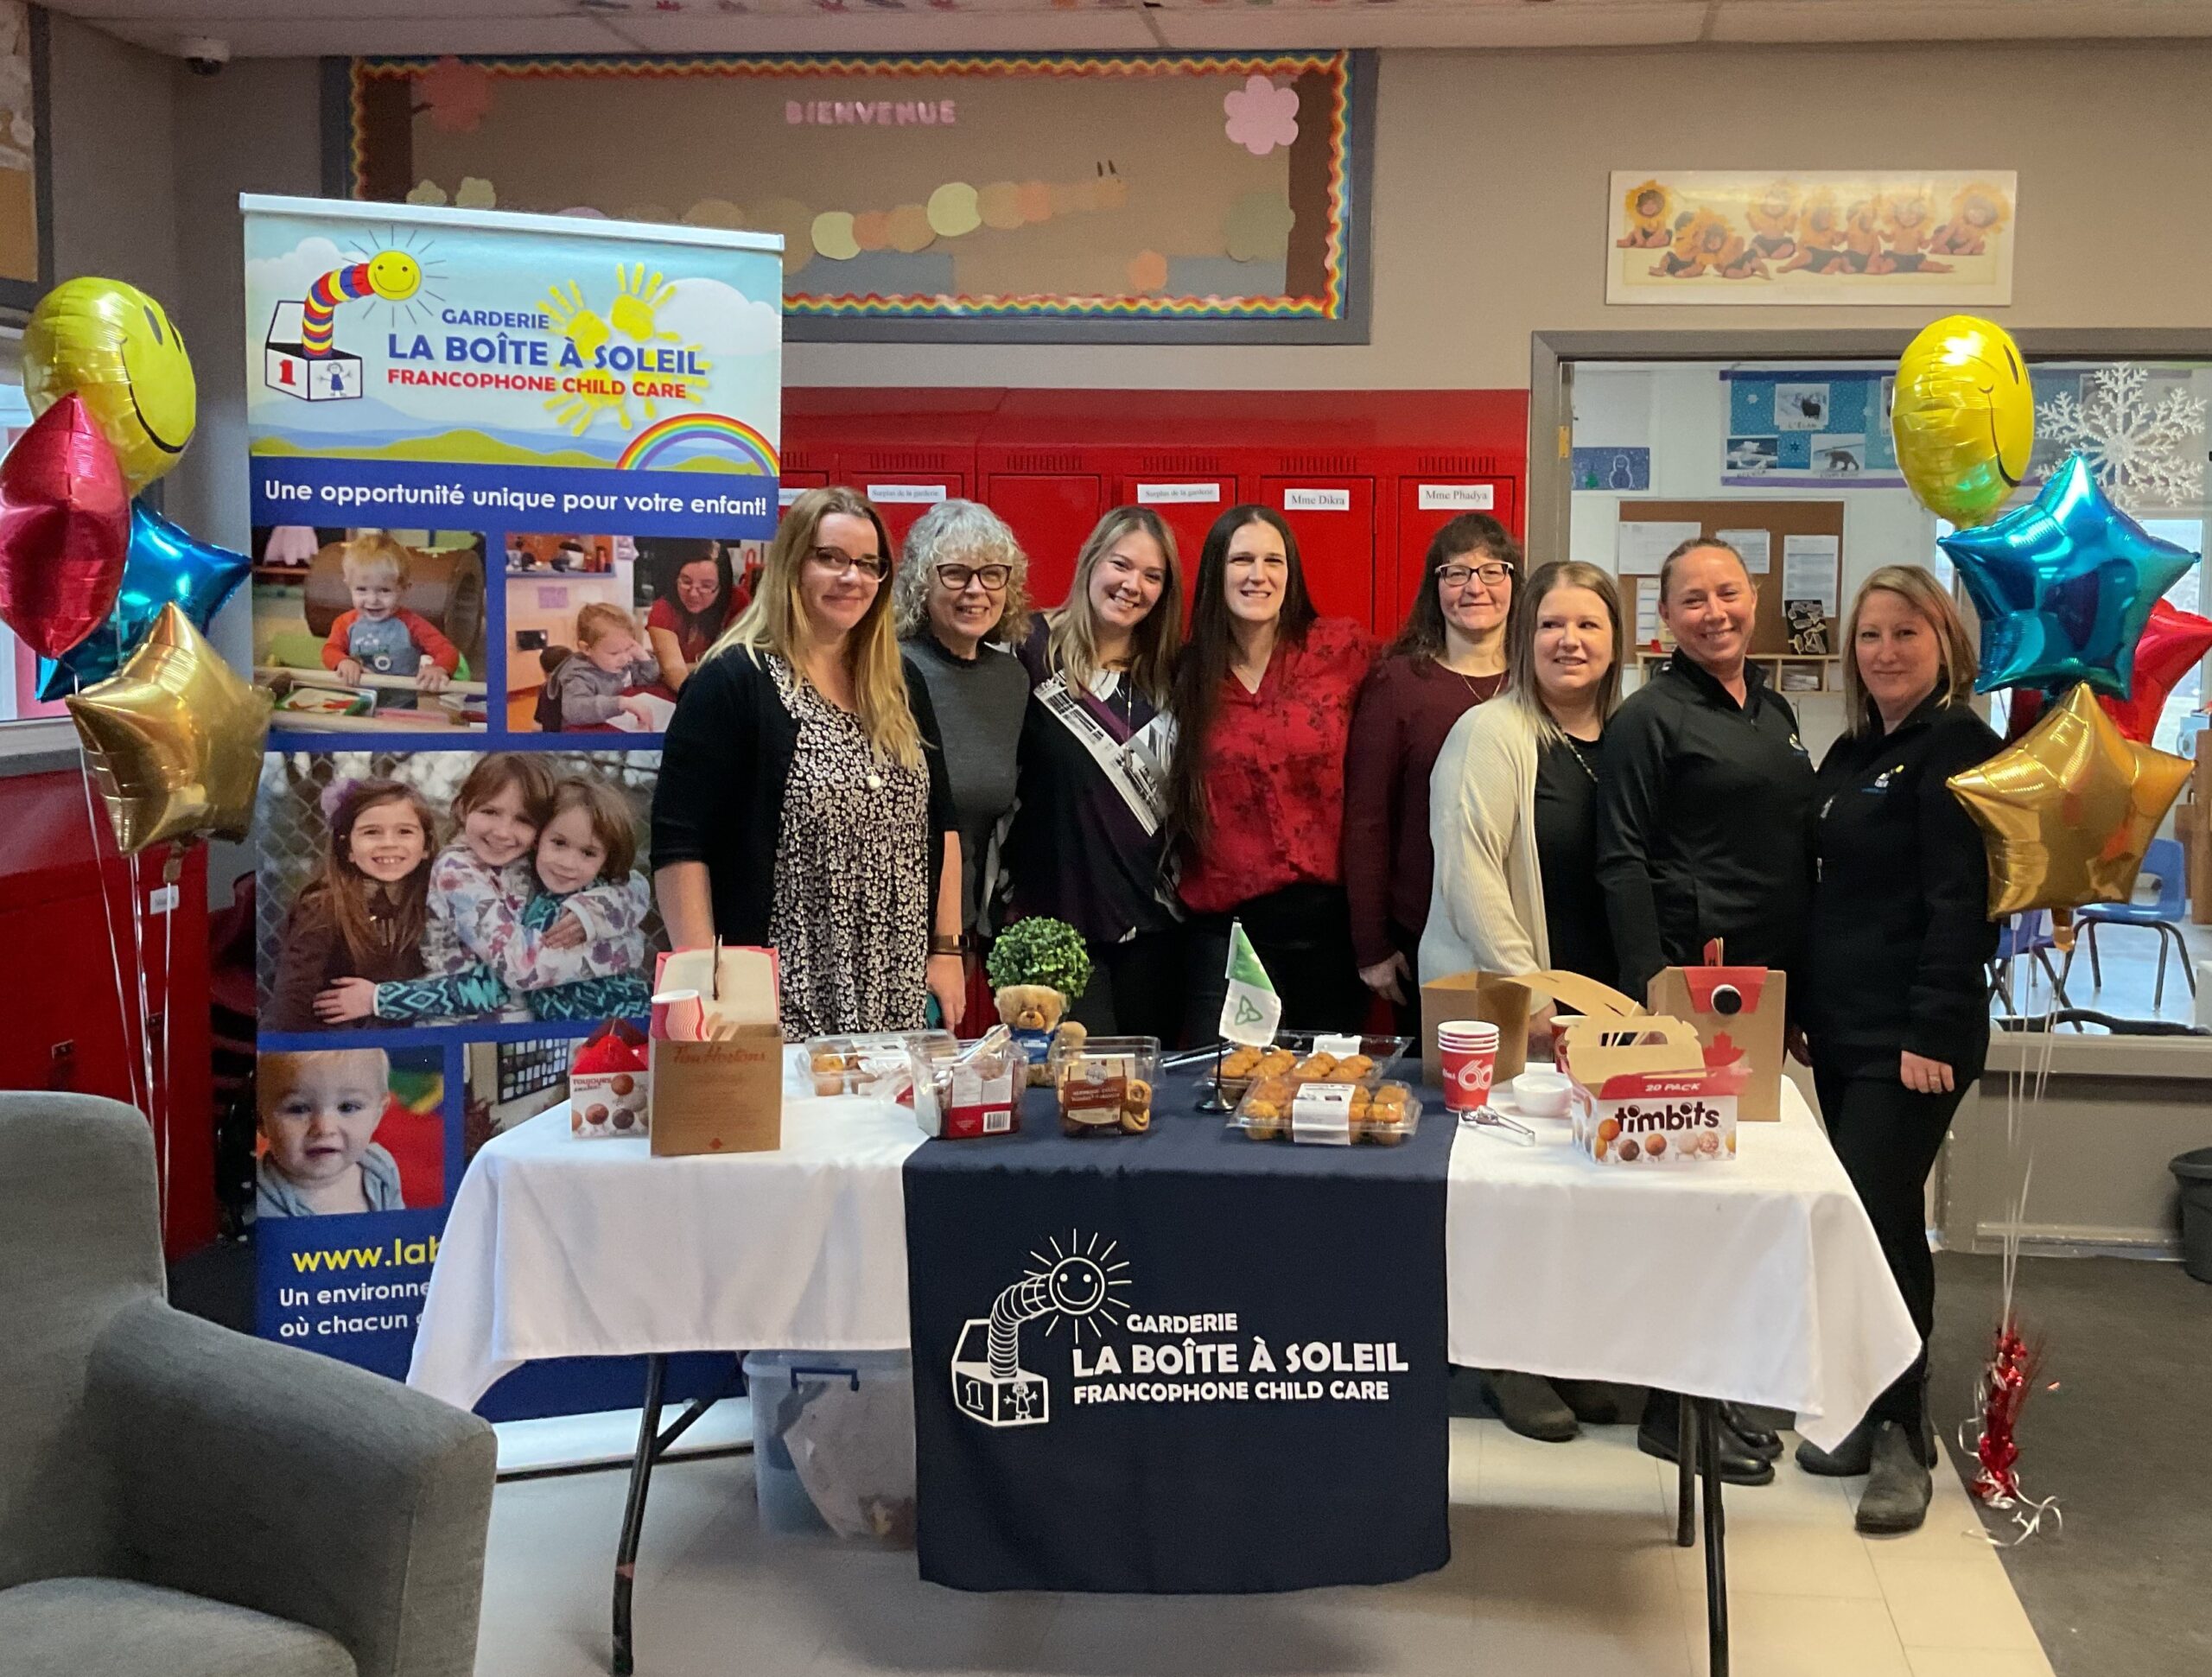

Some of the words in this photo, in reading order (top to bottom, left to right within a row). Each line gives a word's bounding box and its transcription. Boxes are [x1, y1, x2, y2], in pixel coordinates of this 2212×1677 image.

[785, 99, 956, 124] BIENVENUE
[442, 308, 550, 329] GARDERIE
[389, 333, 435, 359] LA
[446, 332, 548, 365] BOÎTE
[560, 337, 583, 368] À
[594, 345, 705, 375] SOLEIL
[388, 369, 556, 391] FRANCOPHONE
[563, 378, 626, 396] CHILD
[632, 381, 686, 398] CARE
[265, 480, 313, 499] Une
[321, 484, 465, 506] opportunité
[473, 487, 556, 511] unique
[563, 493, 618, 513] pour
[624, 492, 683, 511] votre
[690, 495, 766, 516] enfant!
[1292, 495, 1316, 505] Mme
[1319, 495, 1345, 505] Dikra
[1426, 490, 1451, 499] Mme
[1453, 490, 1488, 502] Phadya
[1645, 1083, 1662, 1092] 20
[1664, 1083, 1701, 1092] PACK
[1614, 1101, 1720, 1133] timbits
[280, 1288, 309, 1306] Un
[280, 1316, 309, 1337] où
[317, 1314, 408, 1334] chacun
[1126, 1313, 1238, 1333] GARDERIE
[1072, 1345, 1122, 1377] LA
[1132, 1337, 1238, 1375] BOÎTE
[1249, 1336, 1276, 1373] À
[1286, 1342, 1408, 1374] SOLEIL
[1074, 1382, 1249, 1404] FRANCOPHONE
[1255, 1382, 1324, 1401] CHILD
[1330, 1381, 1389, 1401] CARE
